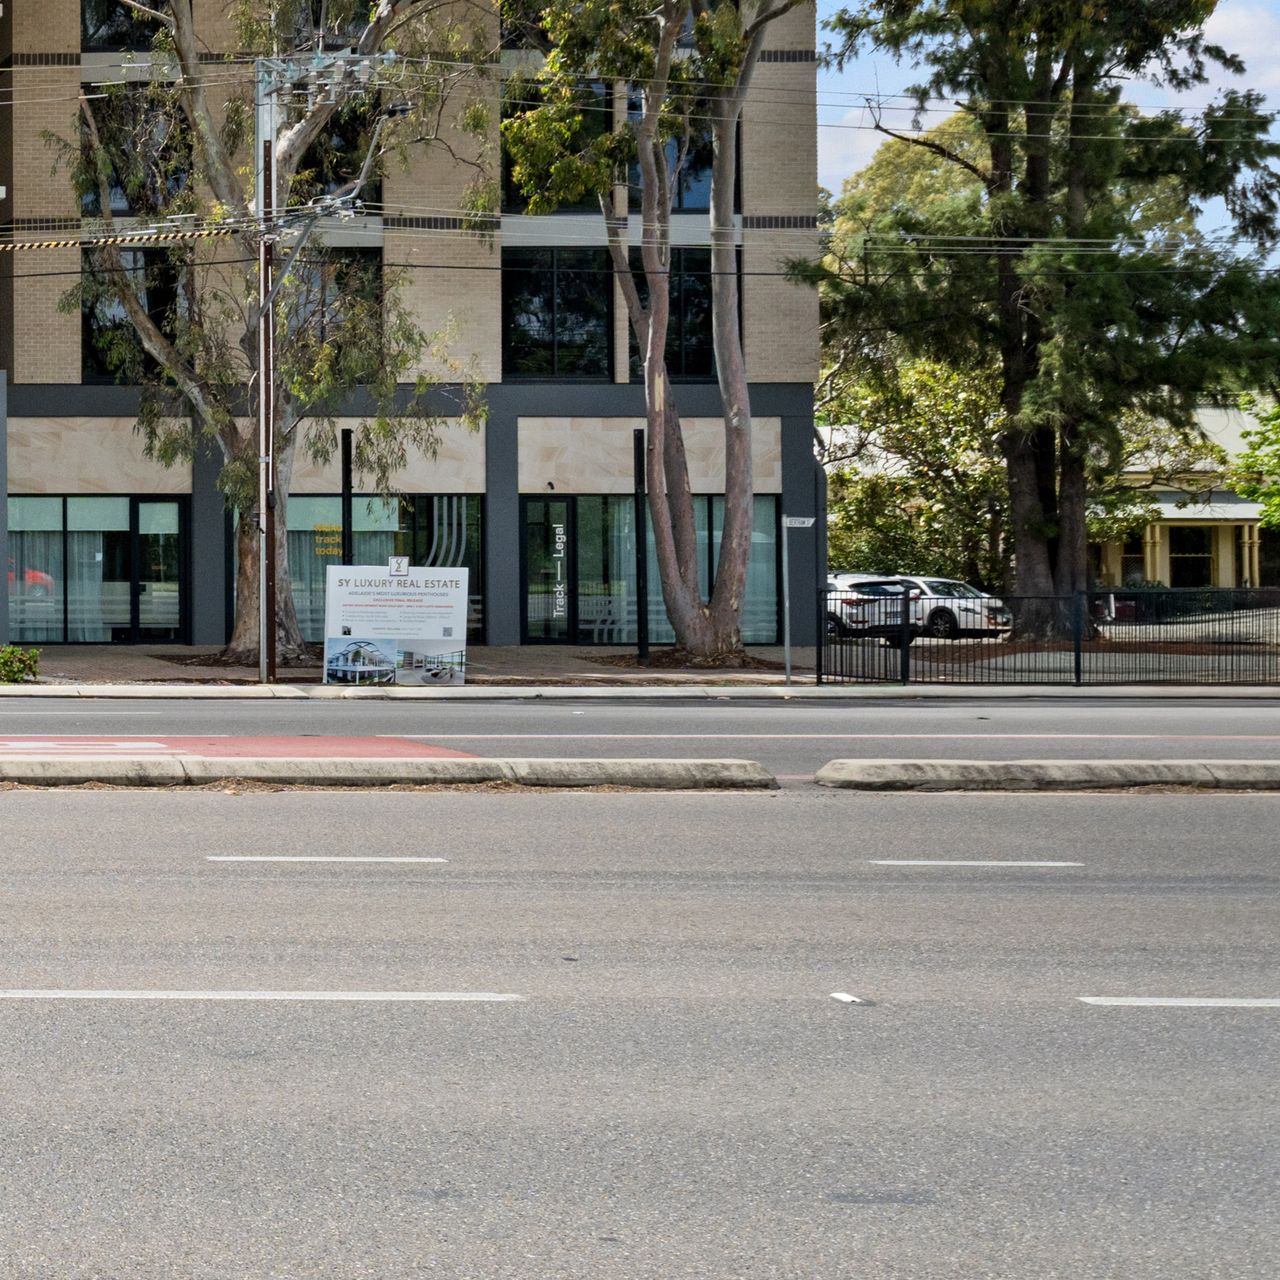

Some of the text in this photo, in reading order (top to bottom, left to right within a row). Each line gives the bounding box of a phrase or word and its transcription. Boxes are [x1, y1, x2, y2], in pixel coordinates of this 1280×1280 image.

[315, 535, 342, 544] track
[552, 524, 566, 557] Legal
[315, 546, 343, 557] today
[338, 579, 460, 589] SY LUXURY REAL ESTATE
[552, 583, 565, 618] Track
